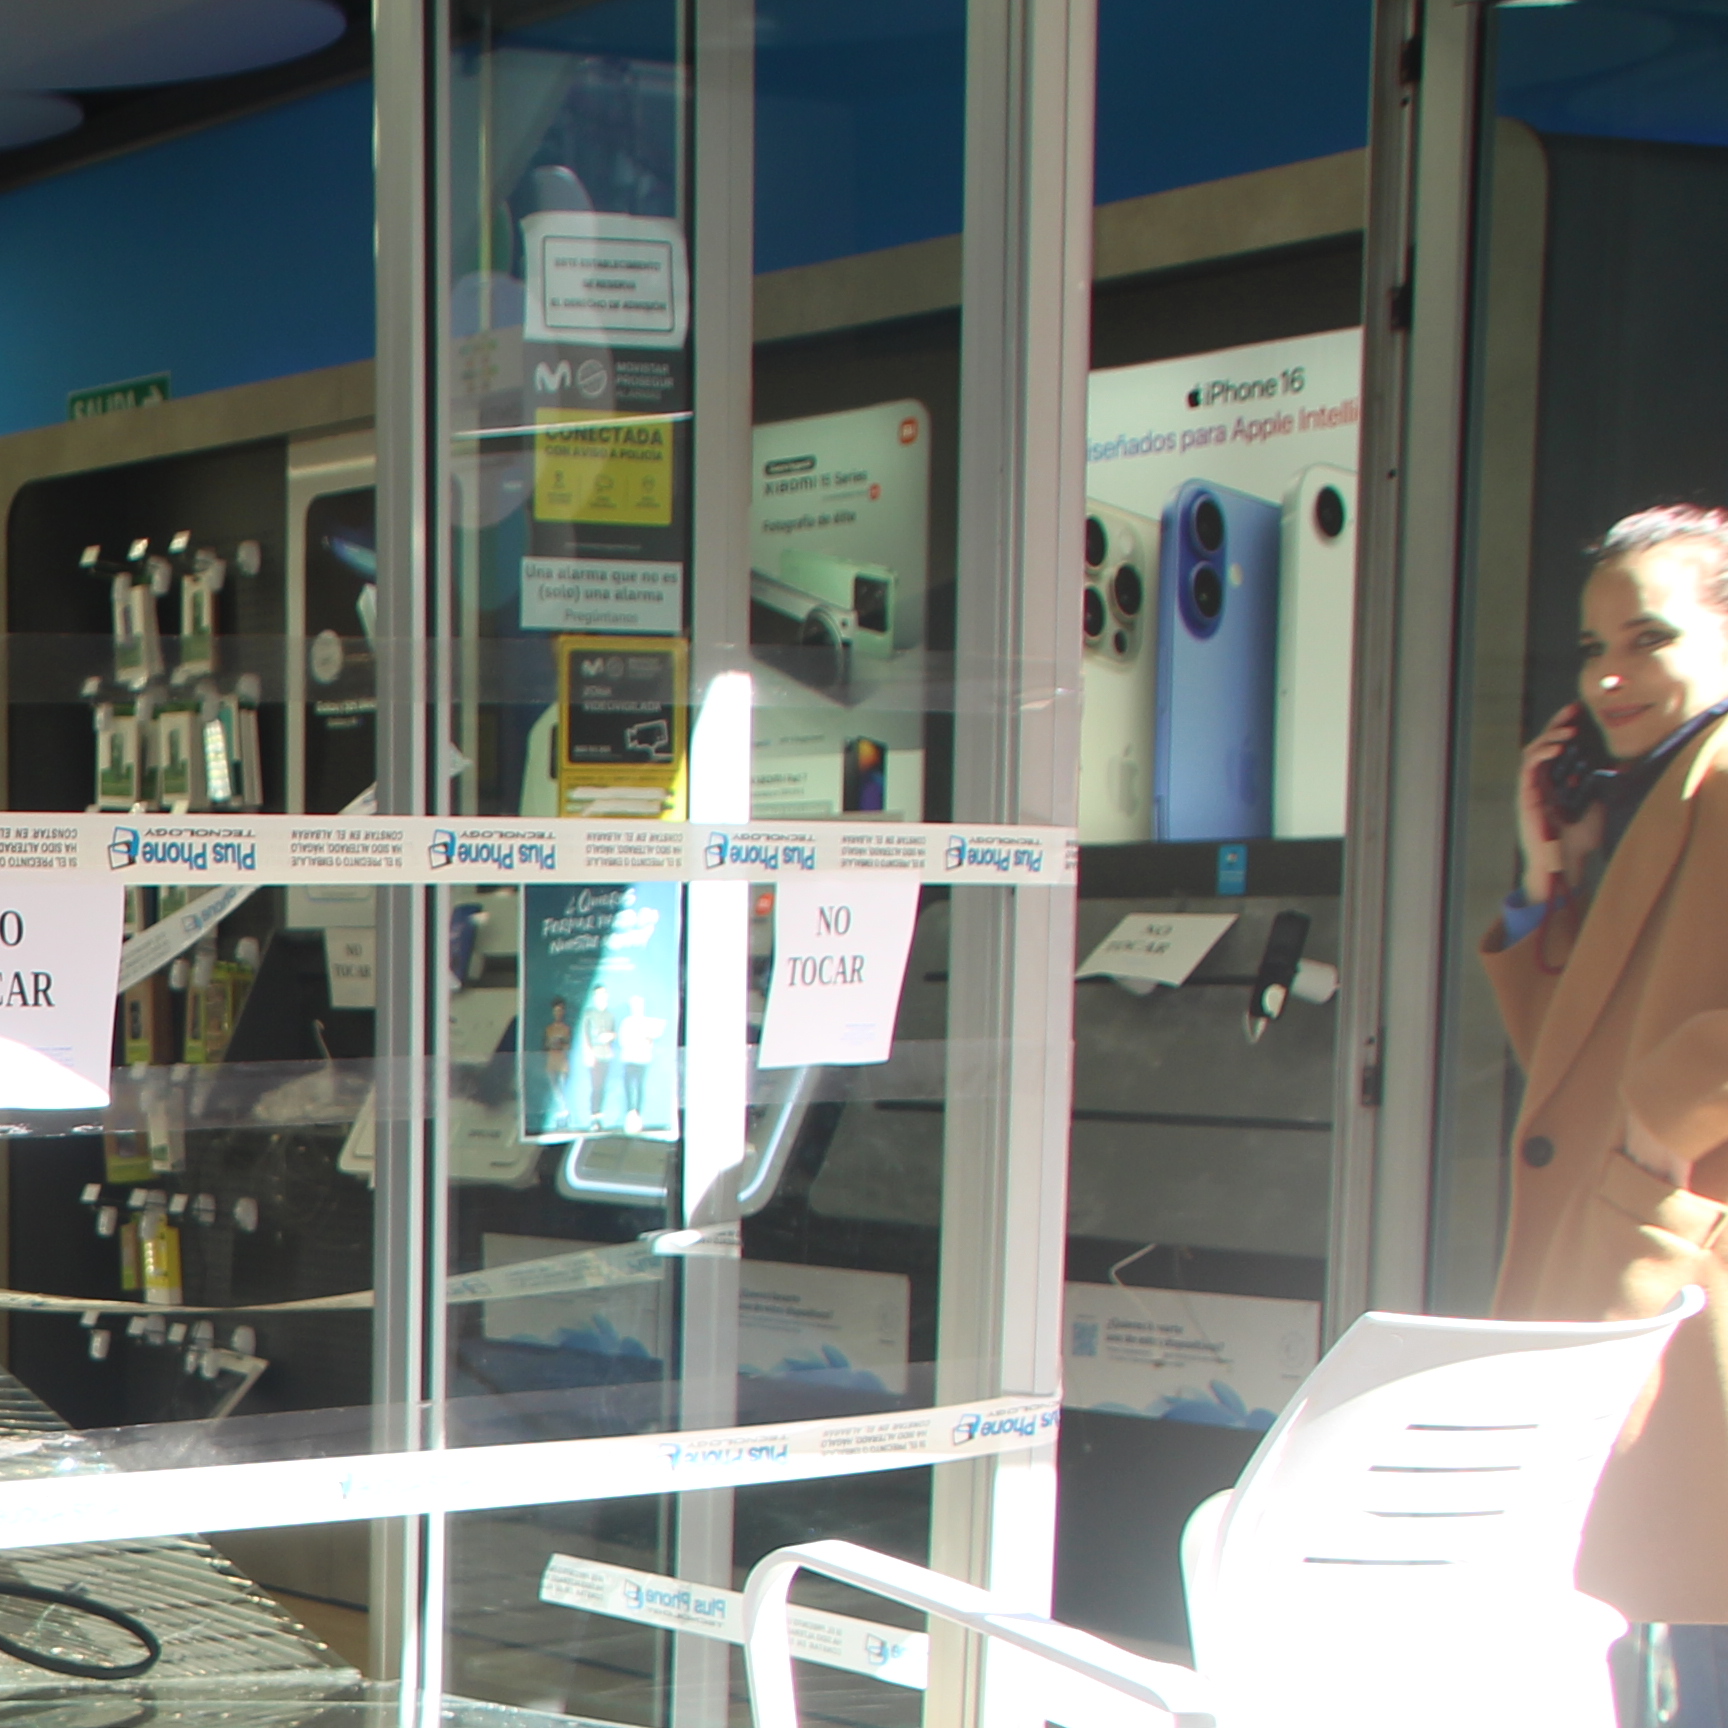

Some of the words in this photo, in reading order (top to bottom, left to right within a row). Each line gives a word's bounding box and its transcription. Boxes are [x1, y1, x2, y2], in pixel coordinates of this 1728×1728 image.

[1202, 375, 1279, 406] iPhone
[1281, 366, 1305, 394] 16
[1180, 420, 1226, 454] para
[1232, 410, 1293, 445] Apple
[817, 906, 851, 936] NO
[787, 955, 865, 986] TOCAR
